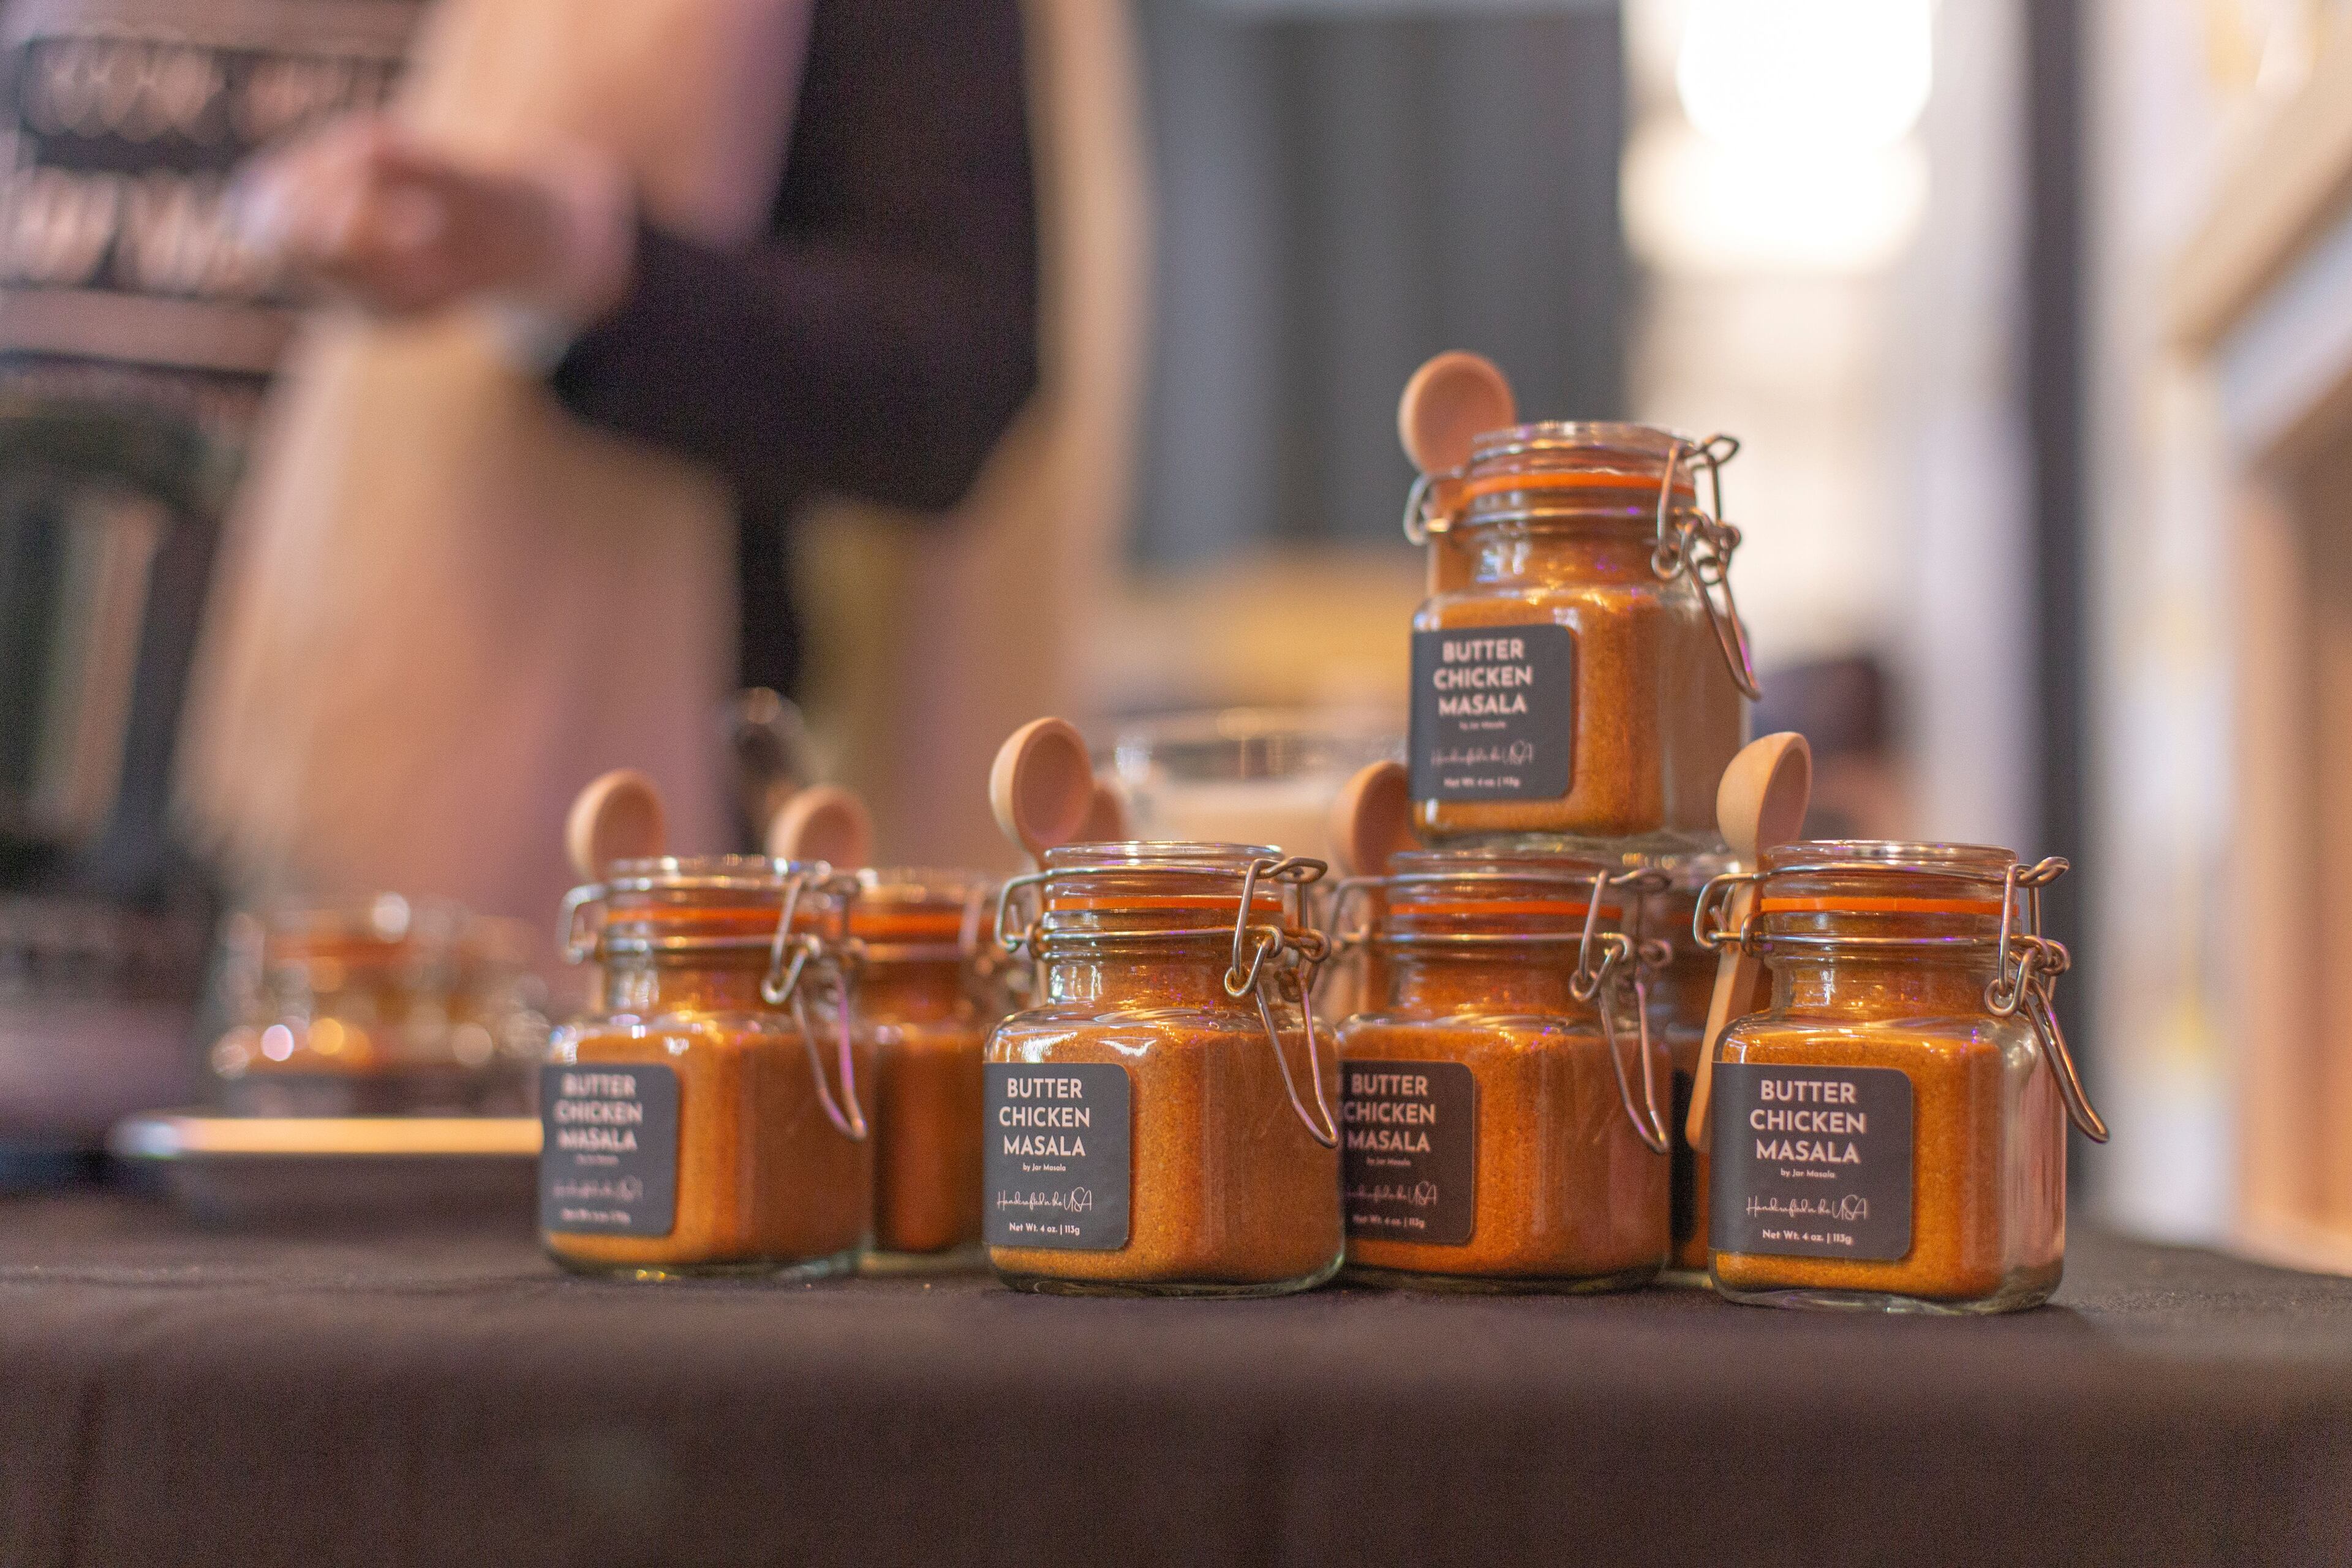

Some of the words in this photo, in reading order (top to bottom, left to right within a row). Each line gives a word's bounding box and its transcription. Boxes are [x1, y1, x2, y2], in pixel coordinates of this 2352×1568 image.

[1442, 638, 1524, 662] BUTTER
[1433, 665, 1532, 690] CHICKEN
[1439, 693, 1527, 715] MASALA
[562, 1074, 636, 1097] BUTTER
[1007, 1078, 1083, 1098] BUTTER
[1351, 1074, 1428, 1096] BUTTER
[1760, 1080, 1857, 1103] BUTTER
[554, 1100, 643, 1124] CHICKEN
[999, 1107, 1090, 1127] CHICKEN
[1344, 1102, 1435, 1124] CHICKEN
[1750, 1109, 1867, 1133] CHICKEN
[557, 1127, 637, 1152] MASALA
[1004, 1134, 1086, 1156] MASALA
[1348, 1131, 1430, 1152] MASALA
[1757, 1139, 1860, 1163] MASALA
[1023, 1163, 1031, 1172] by
[1781, 1168, 1790, 1177] by
[1792, 1169, 1804, 1177] Jar
[1806, 1169, 1836, 1178] Masala
[997, 1189, 1044, 1211] Handcrafted
[1052, 1191, 1063, 1206] the
[1063, 1187, 1092, 1212] USA
[1831, 1194, 1867, 1220] USA
[1009, 1222, 1023, 1232] Net
[1026, 1223, 1038, 1232] Wt.
[1065, 1225, 1080, 1235] 113g
[1763, 1229, 1781, 1240] Net
[1784, 1230, 1800, 1240] Wt.
[1802, 1232, 1807, 1241] 4
[1833, 1233, 1853, 1245] 113g
